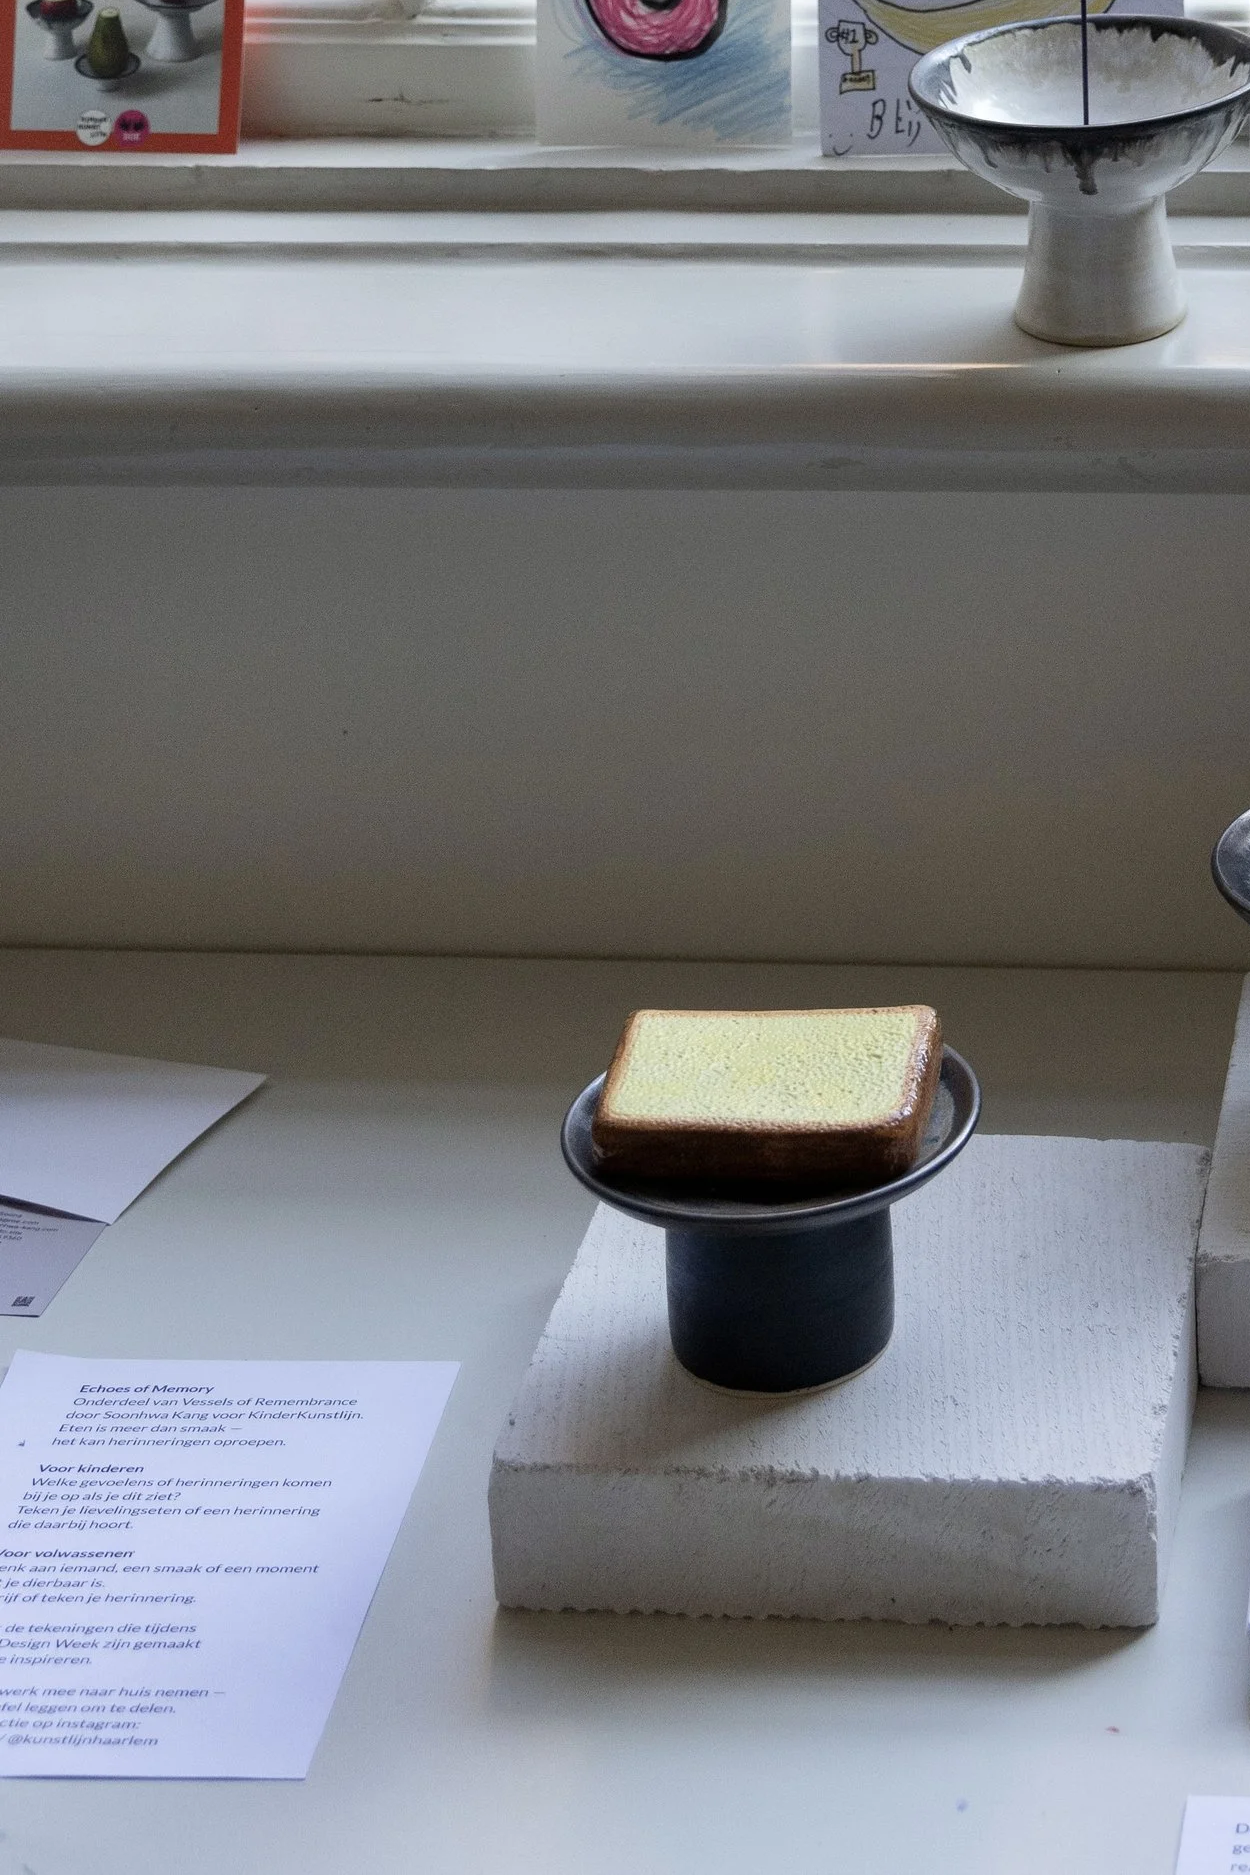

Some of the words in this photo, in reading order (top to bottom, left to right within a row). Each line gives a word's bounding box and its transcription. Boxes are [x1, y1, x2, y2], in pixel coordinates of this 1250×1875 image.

[80, 1384, 131, 1393] Echoes
[134, 1384, 151, 1393] of
[151, 1385, 214, 1395] Memory
[73, 1397, 150, 1406] Onderdeel
[183, 1397, 233, 1406] Vessels
[237, 1397, 252, 1406] of
[254, 1397, 357, 1406] Remembrance
[66, 1411, 100, 1419] door
[102, 1411, 169, 1419] Soonhwa
[172, 1411, 208, 1421] Kang
[212, 1412, 245, 1420] voor
[248, 1411, 364, 1421] KinderKunstlijn.
[58, 1424, 92, 1433] Eten
[95, 1424, 107, 1433] is
[150, 1424, 177, 1433] dan
[179, 1425, 226, 1433] smaak
[52, 1438, 75, 1446] het
[78, 1438, 105, 1446] kan
[108, 1438, 210, 1447] herinneringen
[214, 1438, 286, 1447] oproepen.
[40, 1464, 75, 1473] Voor
[77, 1464, 144, 1473] kinderen
[31, 1478, 78, 1487] Welke
[79, 1478, 154, 1488] gevoelens
[157, 1478, 174, 1487] of
[175, 1478, 279, 1489] herinneringen
[282, 1478, 332, 1487] komen
[23, 1492, 42, 1501] bij
[43, 1492, 58, 1501] je
[60, 1493, 80, 1501] op
[82, 1492, 102, 1501] als
[104, 1492, 120, 1501] je
[122, 1492, 143, 1501] dit
[145, 1492, 181, 1501] ziet?
[17, 1506, 60, 1515] Teken
[60, 1506, 77, 1516] je
[79, 1506, 181, 1516] lievelingseten
[185, 1506, 201, 1515] of
[233, 1506, 320, 1517] herinnering
[7, 1520, 31, 1529] die
[34, 1520, 88, 1531] daarbij
[89, 1520, 133, 1529] hoort.
[34, 1549, 134, 1558] volwassenen
[29, 1565, 56, 1573] aan
[59, 1563, 118, 1574] iemand,
[122, 1565, 151, 1573] een
[153, 1564, 201, 1573] smaak
[205, 1564, 223, 1573] of
[255, 1564, 319, 1573] moment
[4, 1578, 20, 1589] je
[22, 1578, 88, 1587] dierbaar
[90, 1578, 105, 1587] is.
[22, 1593, 40, 1603] of
[41, 1593, 84, 1603] teken
[86, 1593, 101, 1604] je
[104, 1593, 196, 1604] herinnering.
[5, 1624, 24, 1633] de
[28, 1624, 114, 1634] tekeningen
[117, 1623, 141, 1633] die
[144, 1623, 197, 1634] tijdens
[0, 1638, 51, 1650] Design
[55, 1639, 99, 1649] Week
[103, 1639, 131, 1651] zijn
[133, 1639, 202, 1651] gemaakt
[10, 1654, 93, 1666] inspireren.
[42, 1688, 76, 1696] mee
[79, 1688, 115, 1696] naar
[118, 1687, 150, 1697] huis
[154, 1689, 209, 1697] nemen
[24, 1702, 78, 1714] leggen
[80, 1705, 105, 1713] om
[110, 1704, 126, 1713] te
[129, 1703, 176, 1714] delen.
[32, 1720, 53, 1730] op
[8, 1733, 158, 1746] @kunstlijnhaarlem
